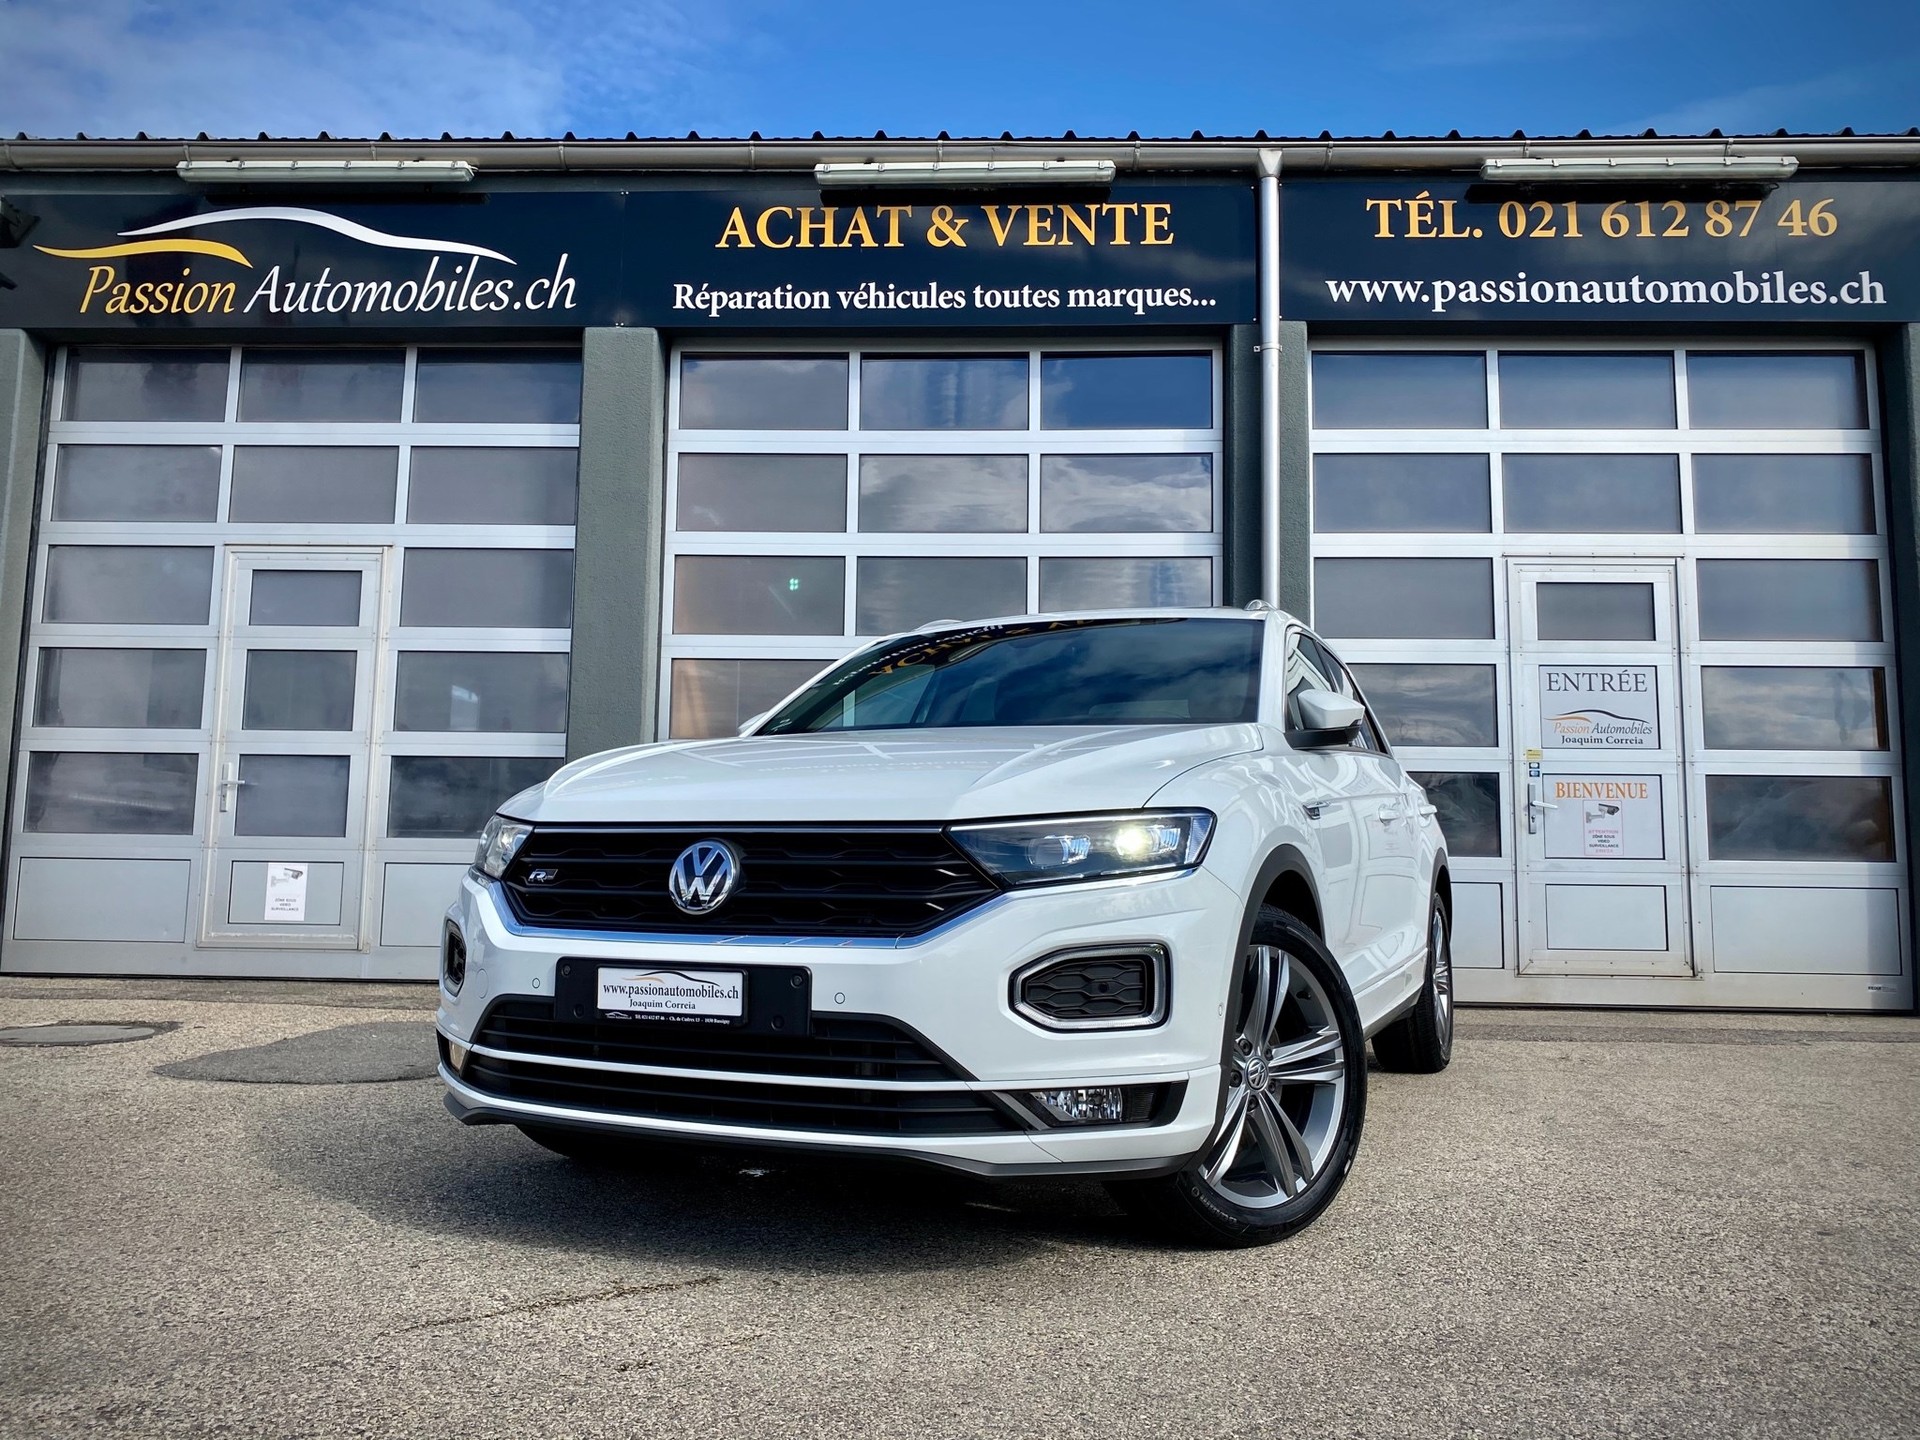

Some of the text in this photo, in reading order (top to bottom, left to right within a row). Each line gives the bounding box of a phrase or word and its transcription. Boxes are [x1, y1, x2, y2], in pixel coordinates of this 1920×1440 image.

[714, 203, 1174, 249] ACHAT & VENTE
[1366, 191, 1838, 239] TÉL. 021 612 87 46
[80, 252, 577, 314] Passion Automobiles.ch
[1325, 271, 1887, 313] www.passionautomobiles.ch
[673, 281, 1217, 318] Réparation véhicules toutes marques...
[1546, 669, 1648, 692] ENTRÉE
[1554, 722, 1653, 735] Passion Automobiles
[1561, 735, 1644, 745] Joaquim Correia
[1555, 782, 1648, 799] BIENVENUE
[603, 983, 739, 999] www.passionautomobiles.ch
[629, 999, 696, 1010] Joaquim Correia
